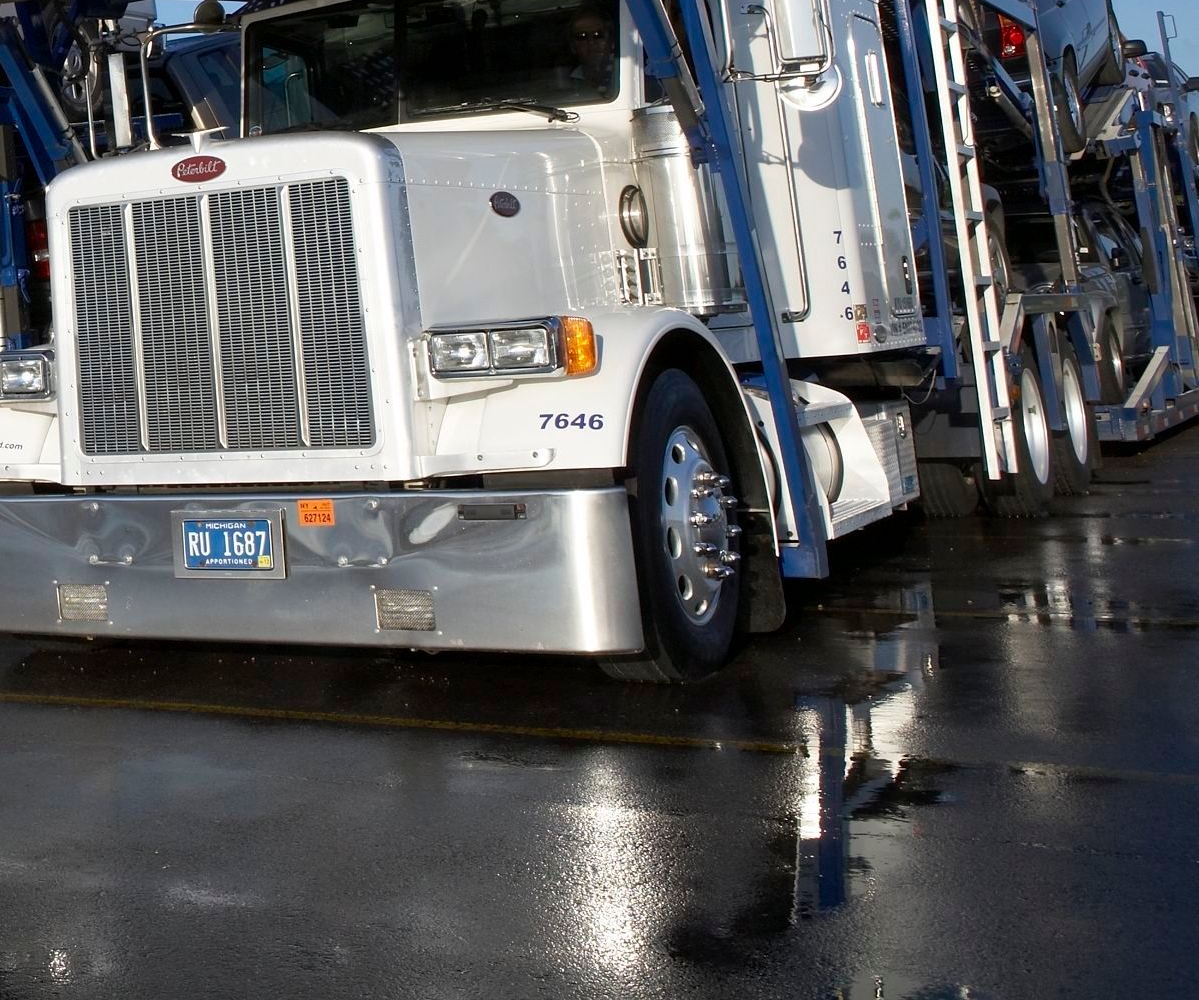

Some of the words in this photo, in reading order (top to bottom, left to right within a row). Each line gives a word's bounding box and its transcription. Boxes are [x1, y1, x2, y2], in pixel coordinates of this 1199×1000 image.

[176, 160, 221, 178] Peterbilt
[539, 413, 604, 430] 7646
[205, 522, 246, 530] MICHIGAN
[304, 513, 331, 523] 627124
[188, 531, 211, 557] RU
[223, 531, 266, 557] 1687
